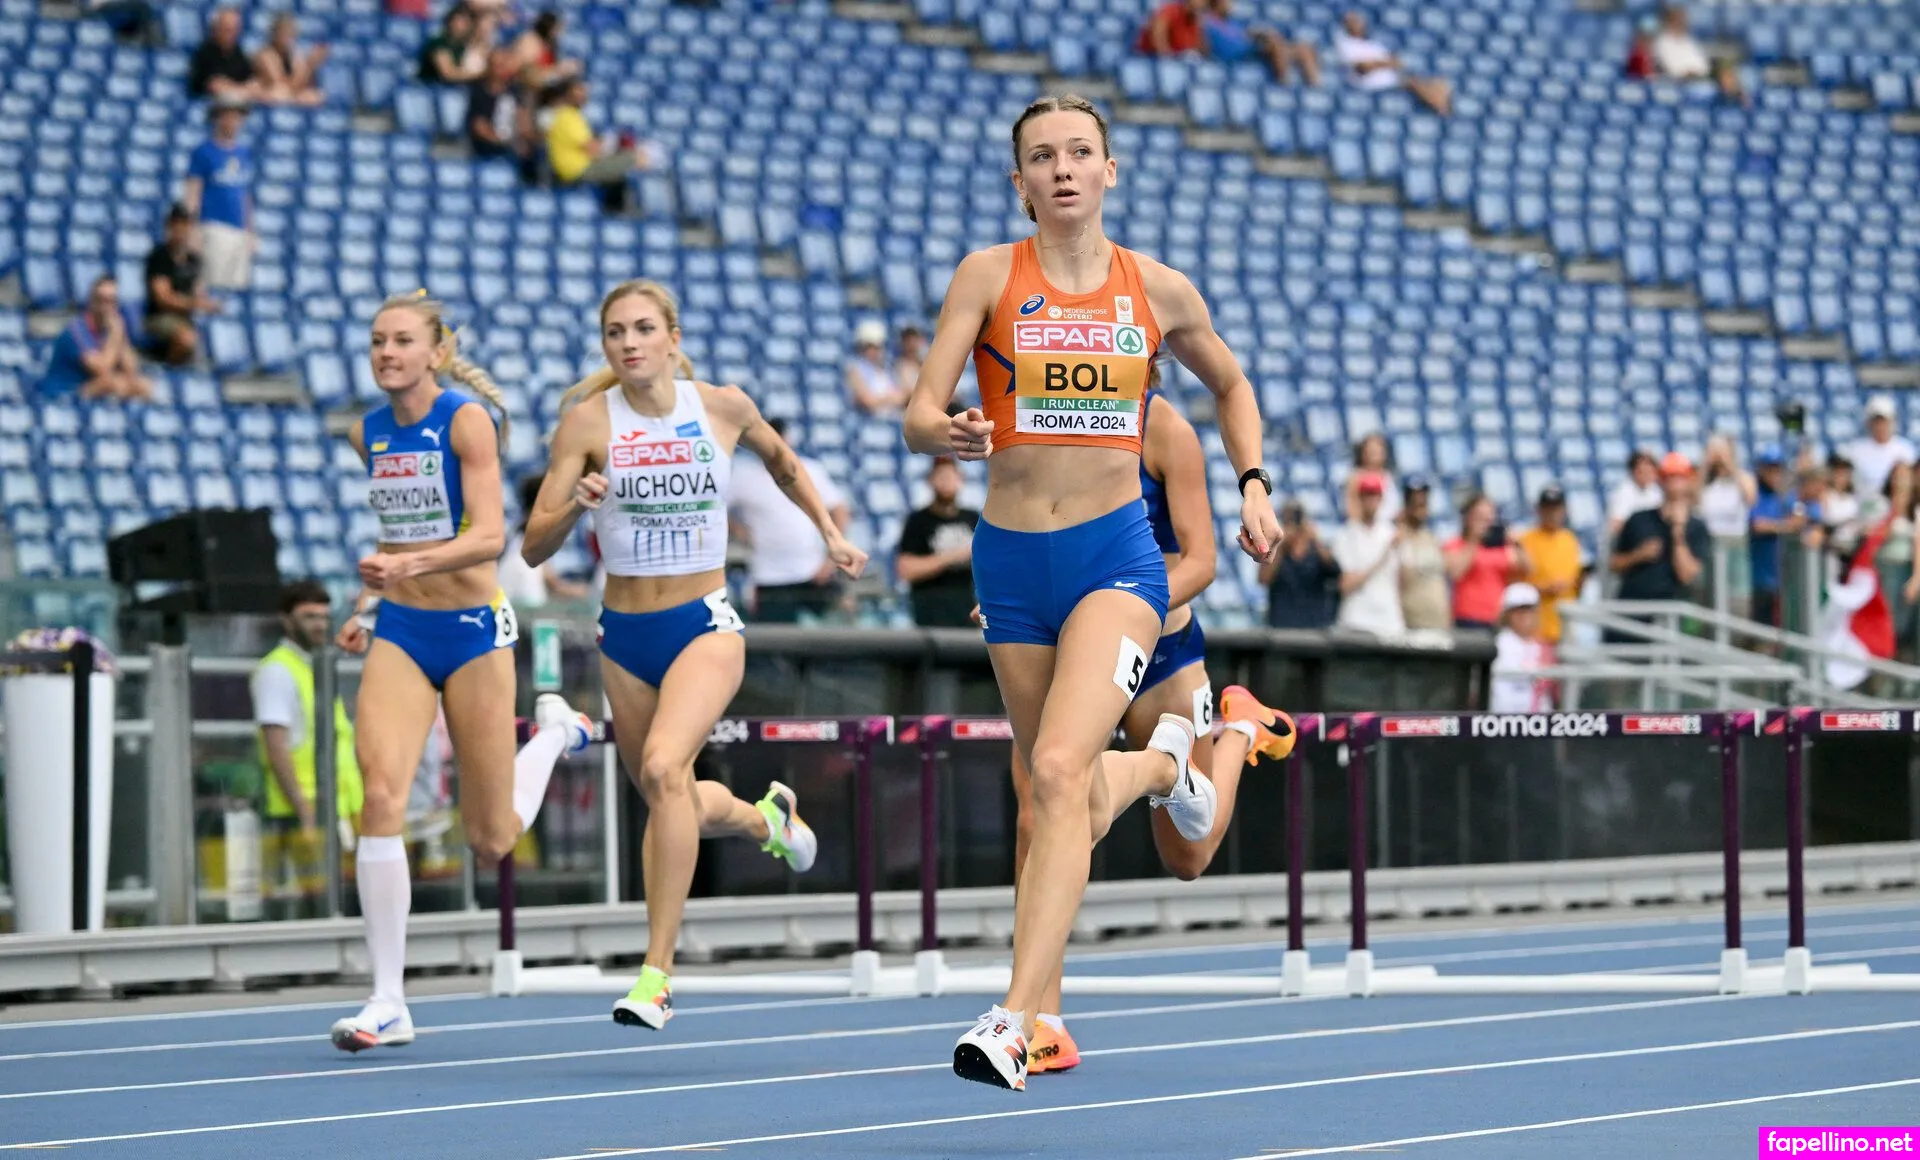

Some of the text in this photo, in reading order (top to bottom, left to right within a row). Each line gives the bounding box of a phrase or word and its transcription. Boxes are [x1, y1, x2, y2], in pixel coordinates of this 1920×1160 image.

[1063, 307, 1108, 315] NEDERLANDSE
[1019, 327, 1111, 348] SPAR
[1045, 363, 1118, 393] BOL
[1048, 399, 1075, 409] RUN
[1033, 414, 1127, 430] ROMA 2024
[613, 443, 690, 466] SPAR
[615, 467, 717, 499] JÍCHOVÁ
[631, 515, 707, 528] ROMA 2024
[1127, 655, 1143, 693] 5
[1471, 714, 1548, 737] roma
[1550, 713, 1609, 737] 2024
